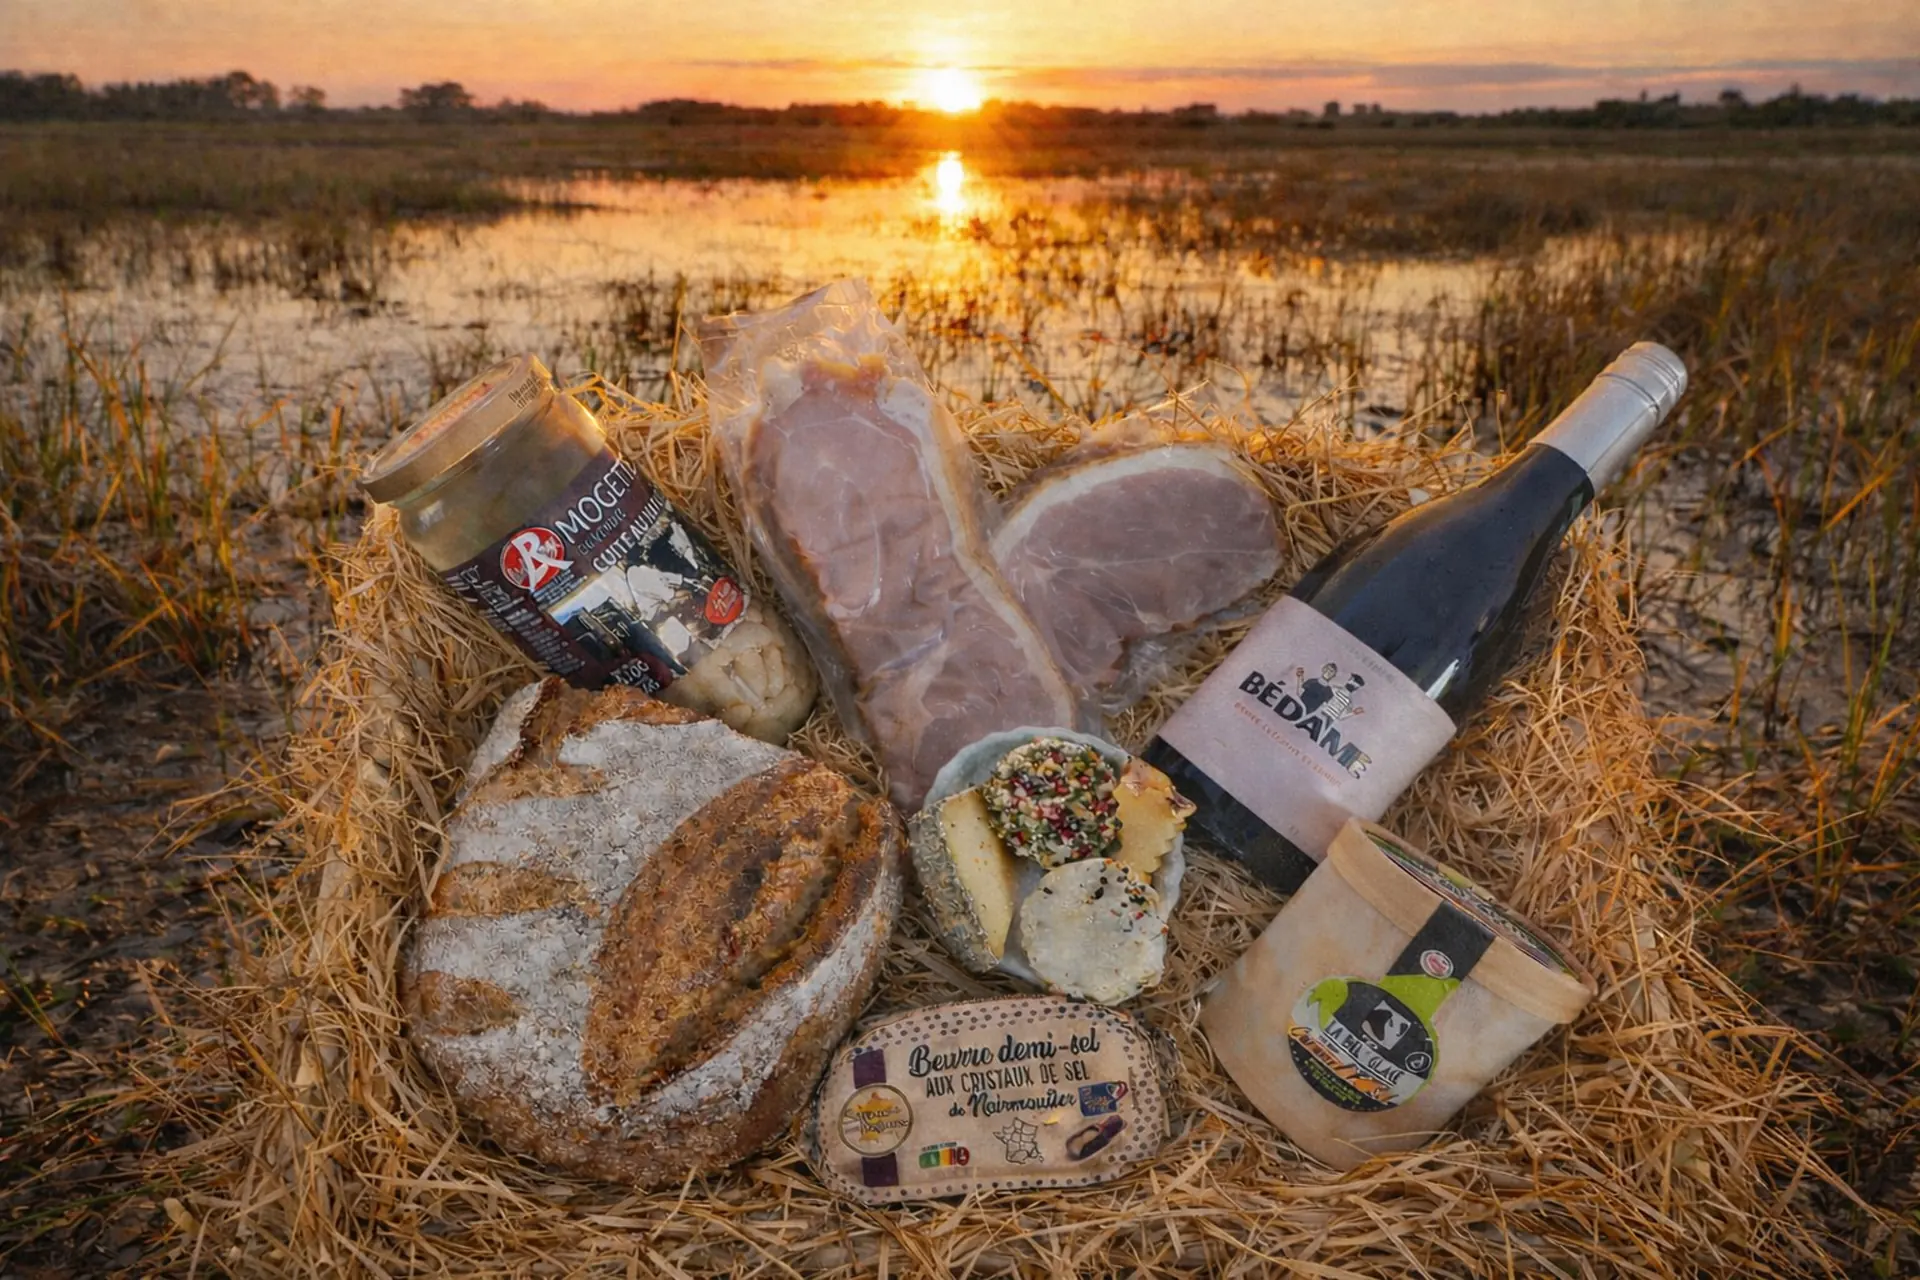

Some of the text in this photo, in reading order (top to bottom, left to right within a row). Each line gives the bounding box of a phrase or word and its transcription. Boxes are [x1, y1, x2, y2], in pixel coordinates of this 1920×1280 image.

[998, 1027, 1100, 1063] demi-sel
[926, 1060, 1091, 1098] AUX CRISTAUX DE SEL
